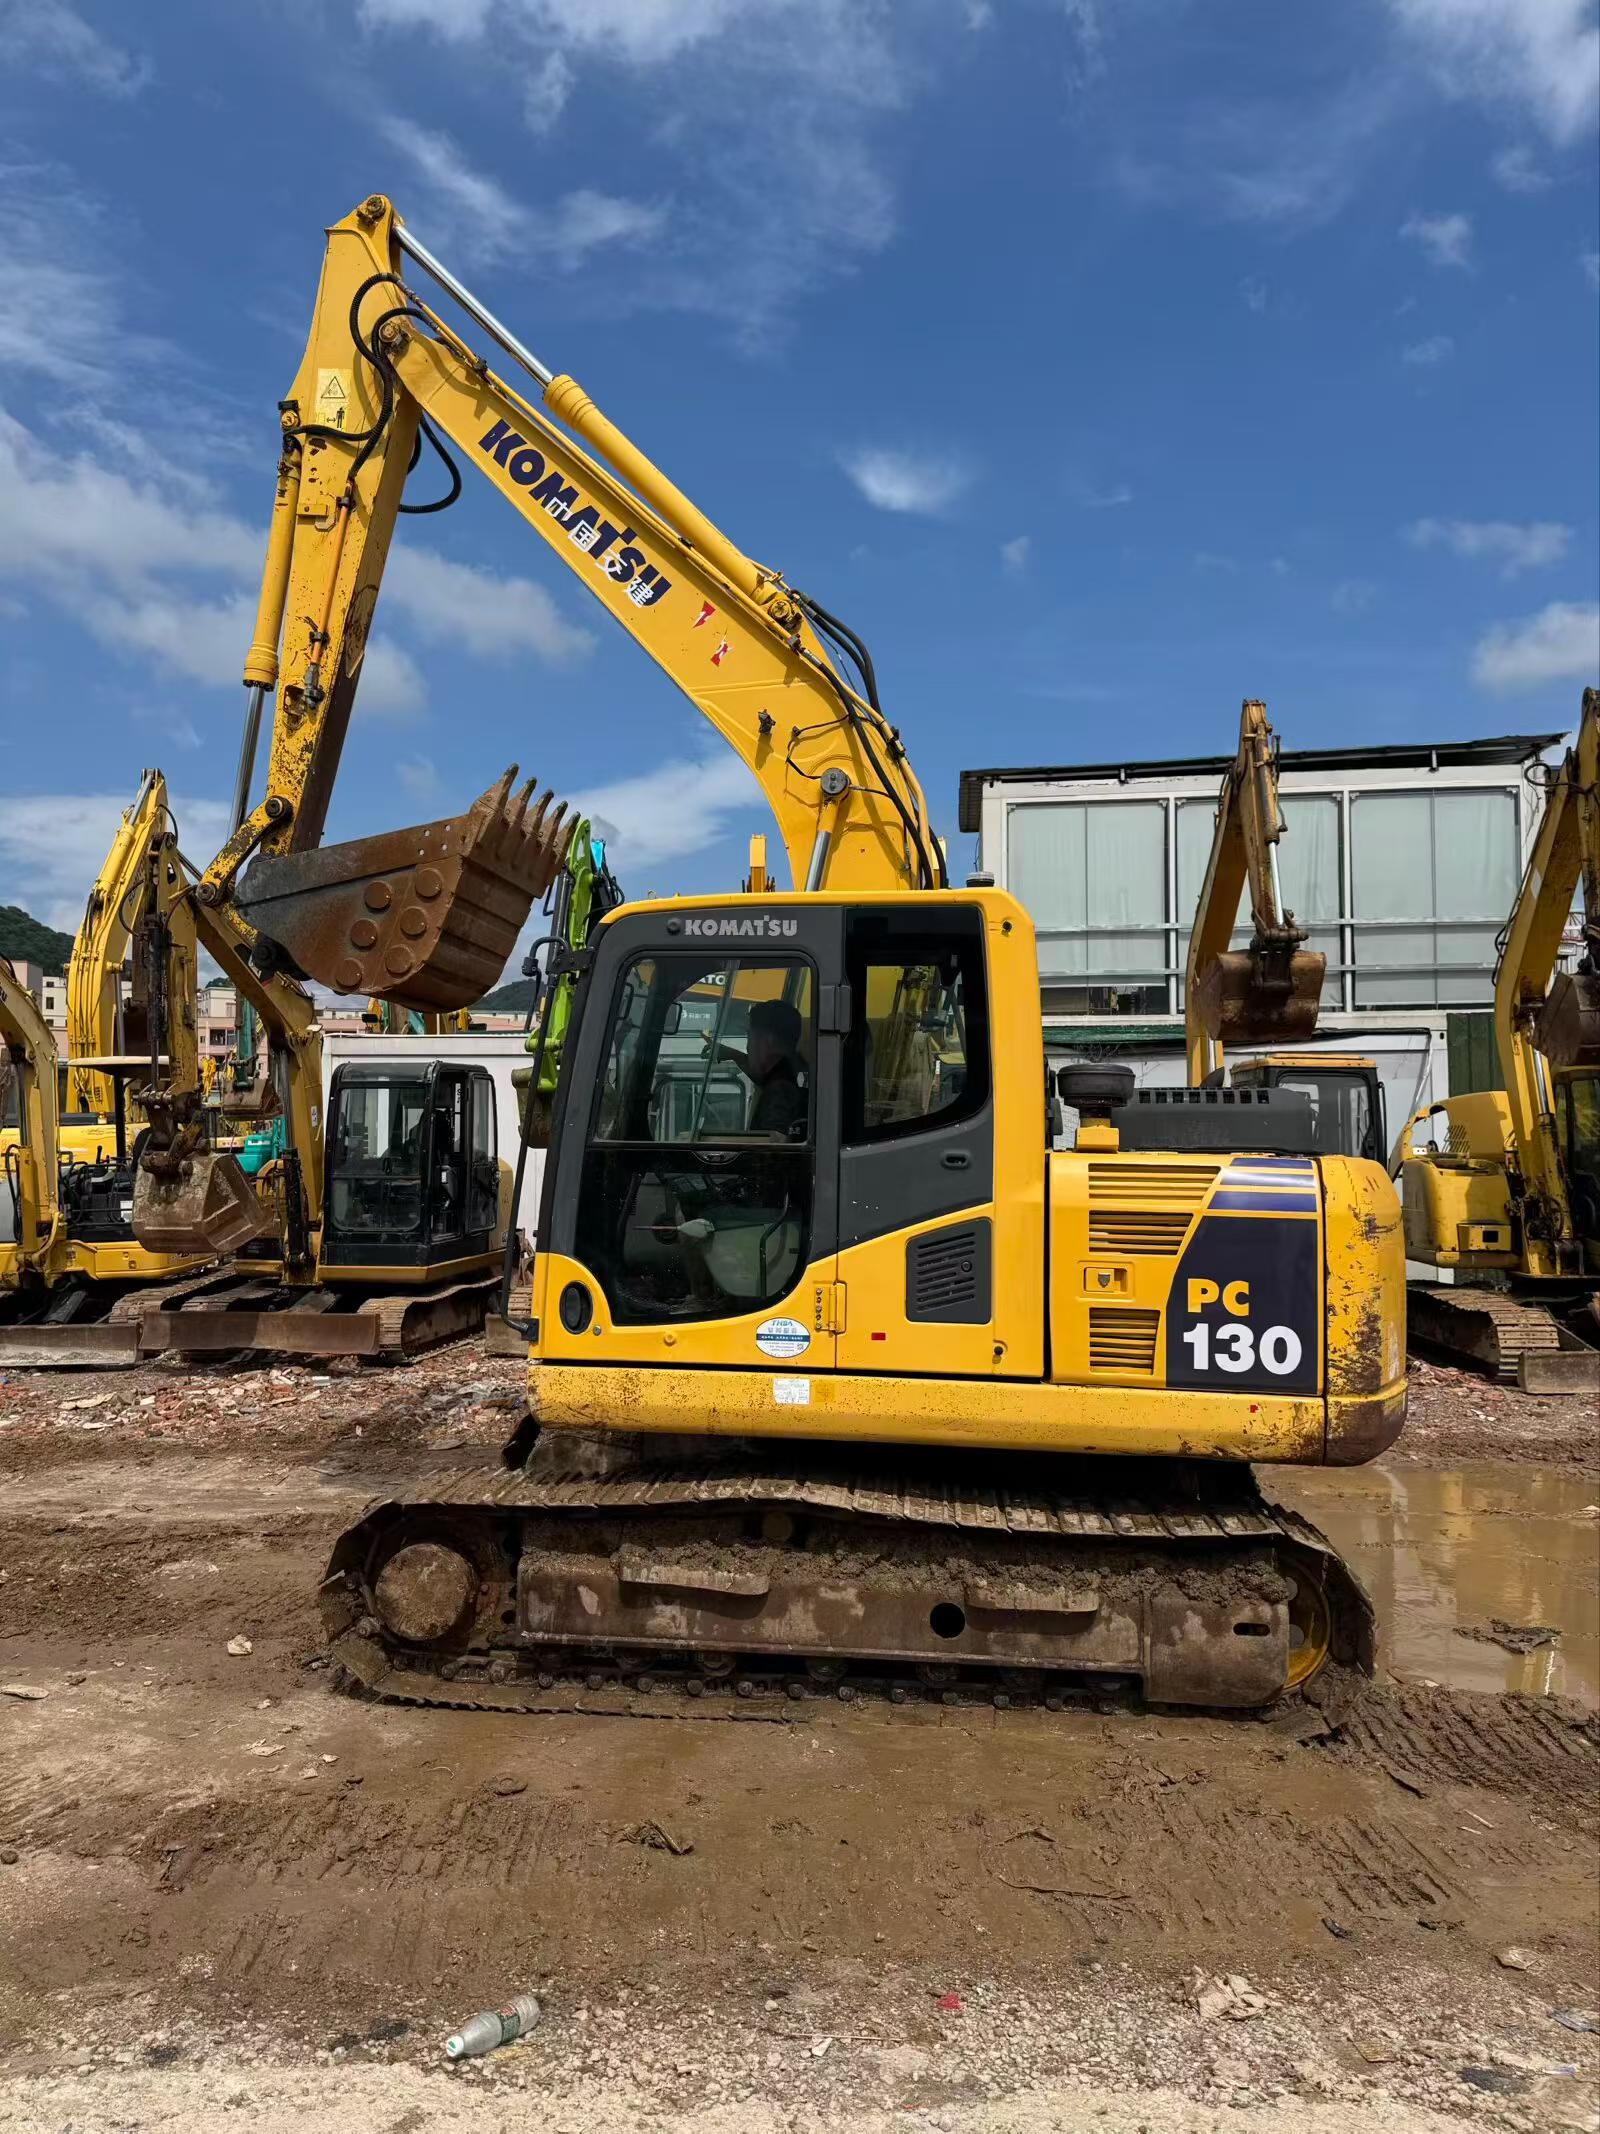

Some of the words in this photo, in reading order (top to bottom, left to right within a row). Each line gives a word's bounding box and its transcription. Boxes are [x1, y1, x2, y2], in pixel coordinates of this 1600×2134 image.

[478, 418, 672, 607] KOMATSU
[685, 915, 798, 937] KOMATSU
[1187, 1278, 1250, 1317] PC
[1183, 1322, 1302, 1376] 130
